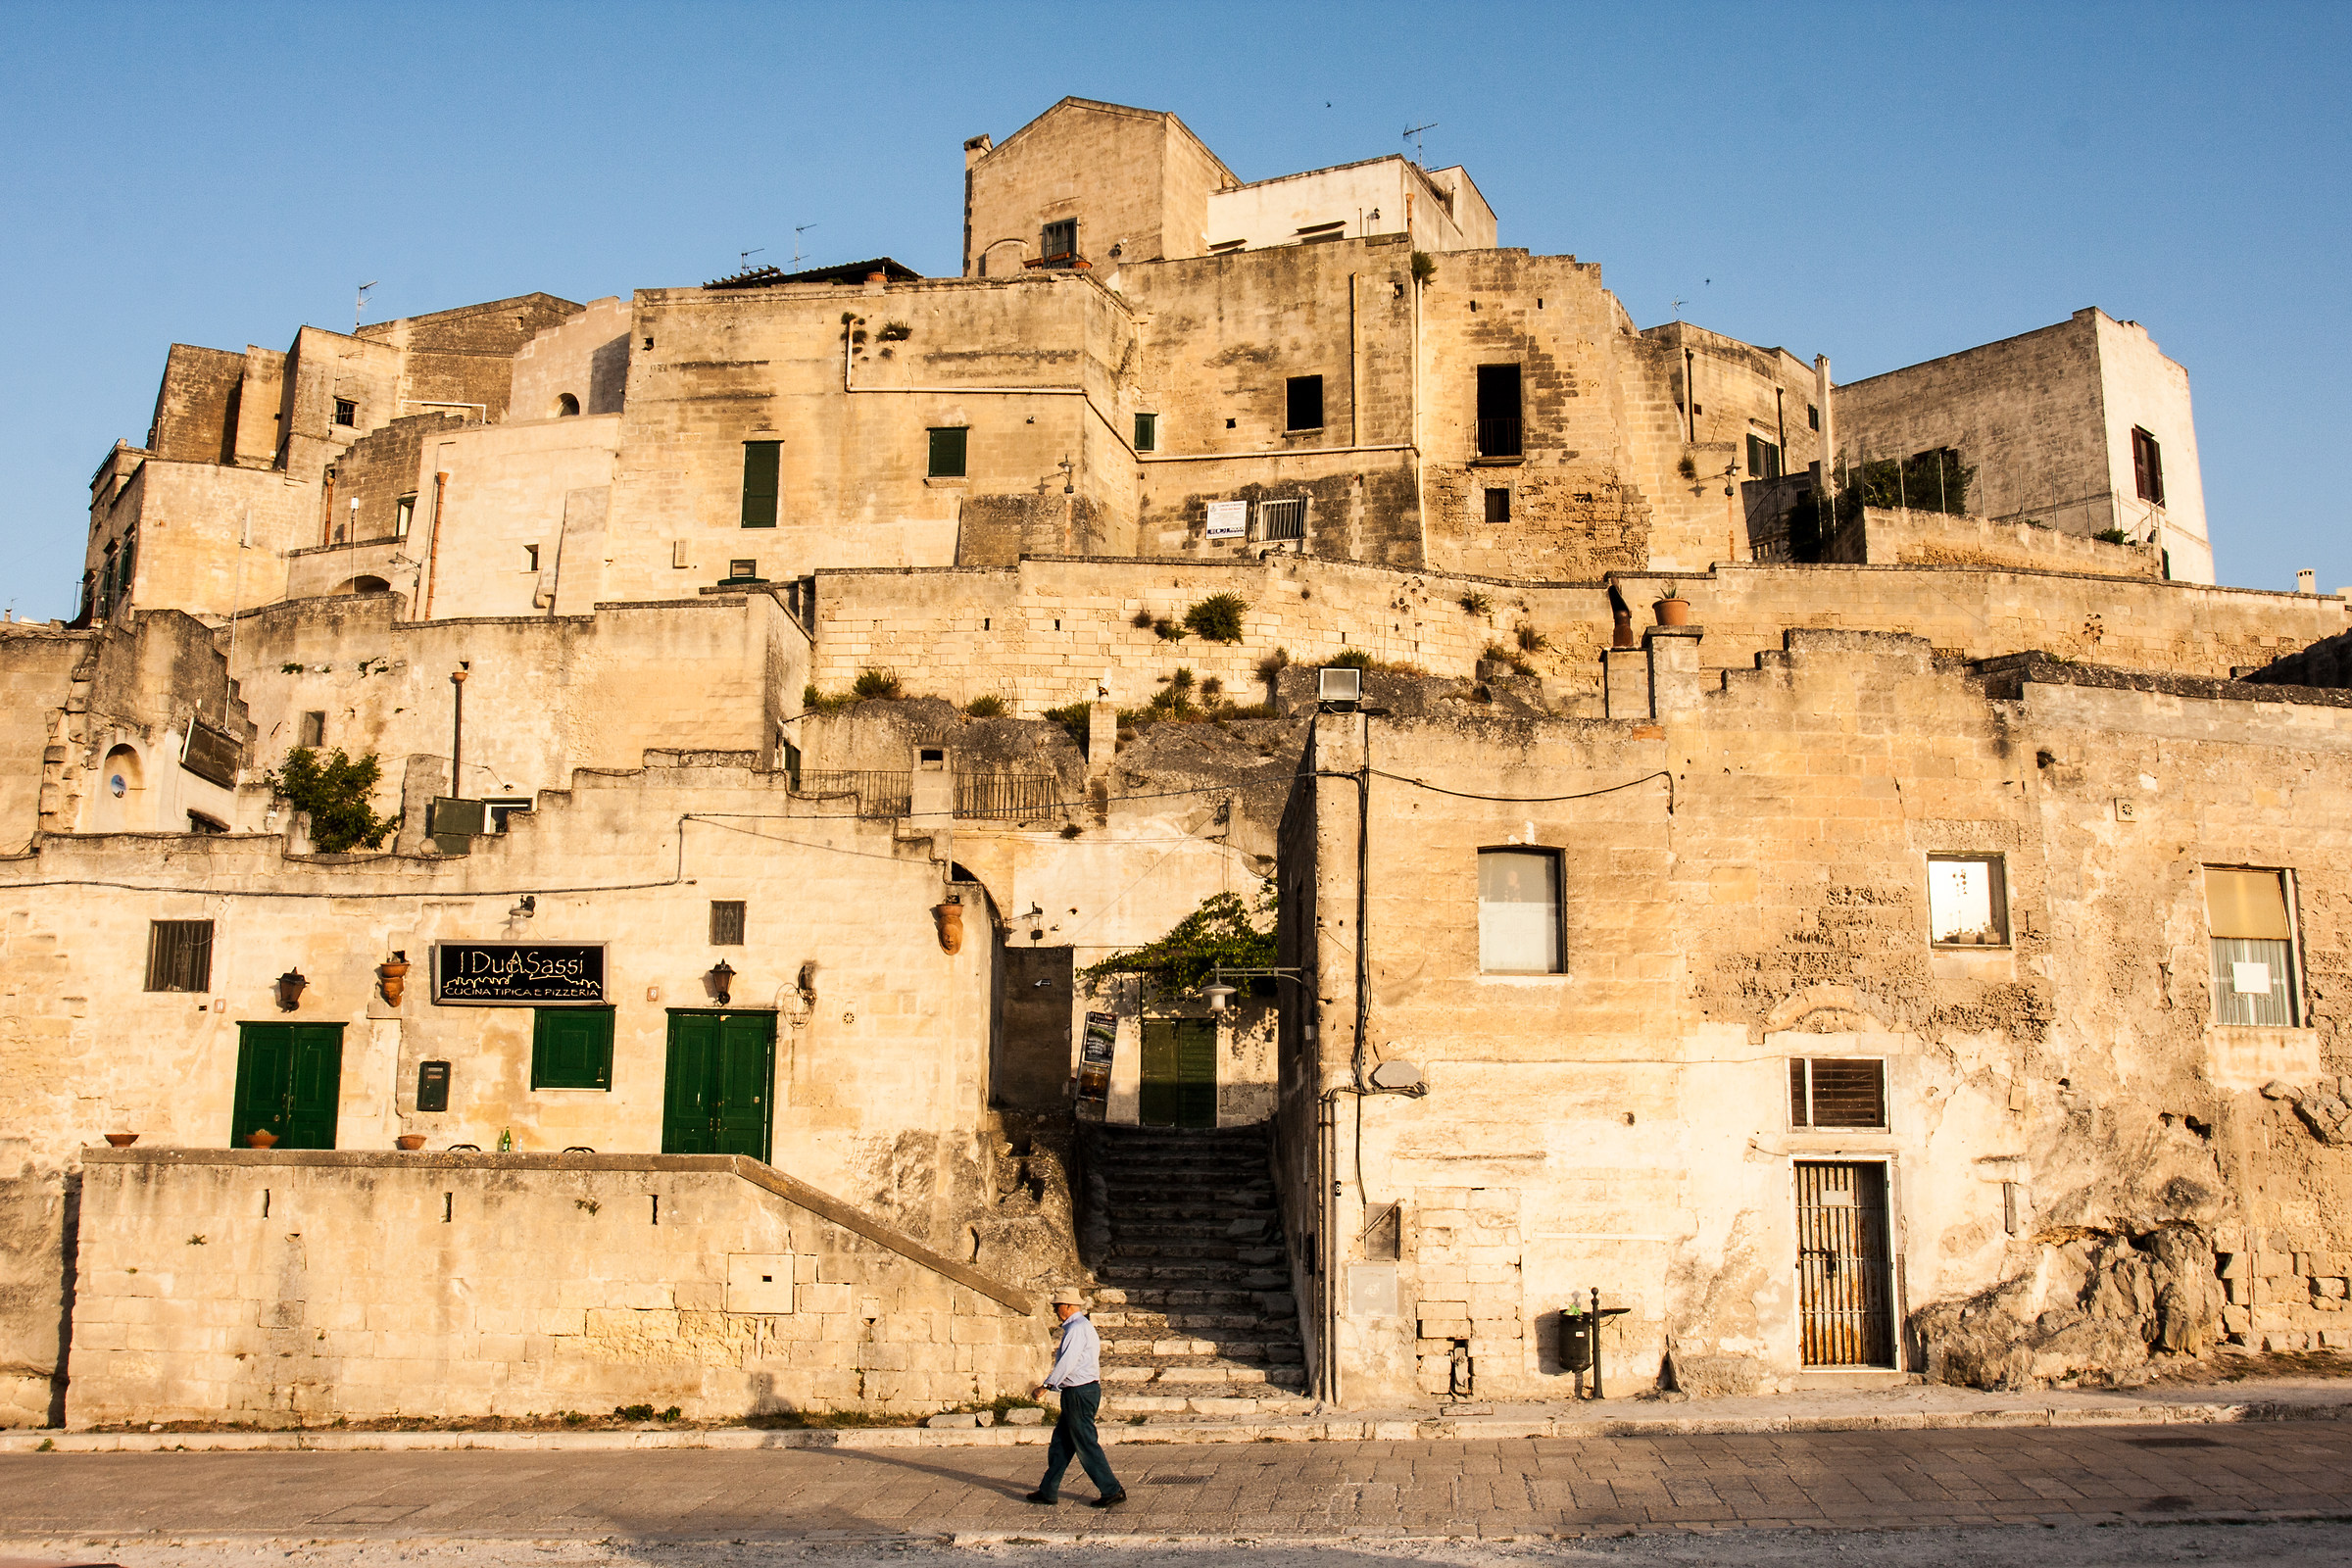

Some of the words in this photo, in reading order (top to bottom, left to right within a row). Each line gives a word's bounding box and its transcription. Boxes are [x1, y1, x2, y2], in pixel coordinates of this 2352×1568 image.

[461, 951, 465, 973] I
[524, 951, 584, 974] Sassi
[494, 988, 532, 997] TIPICA
